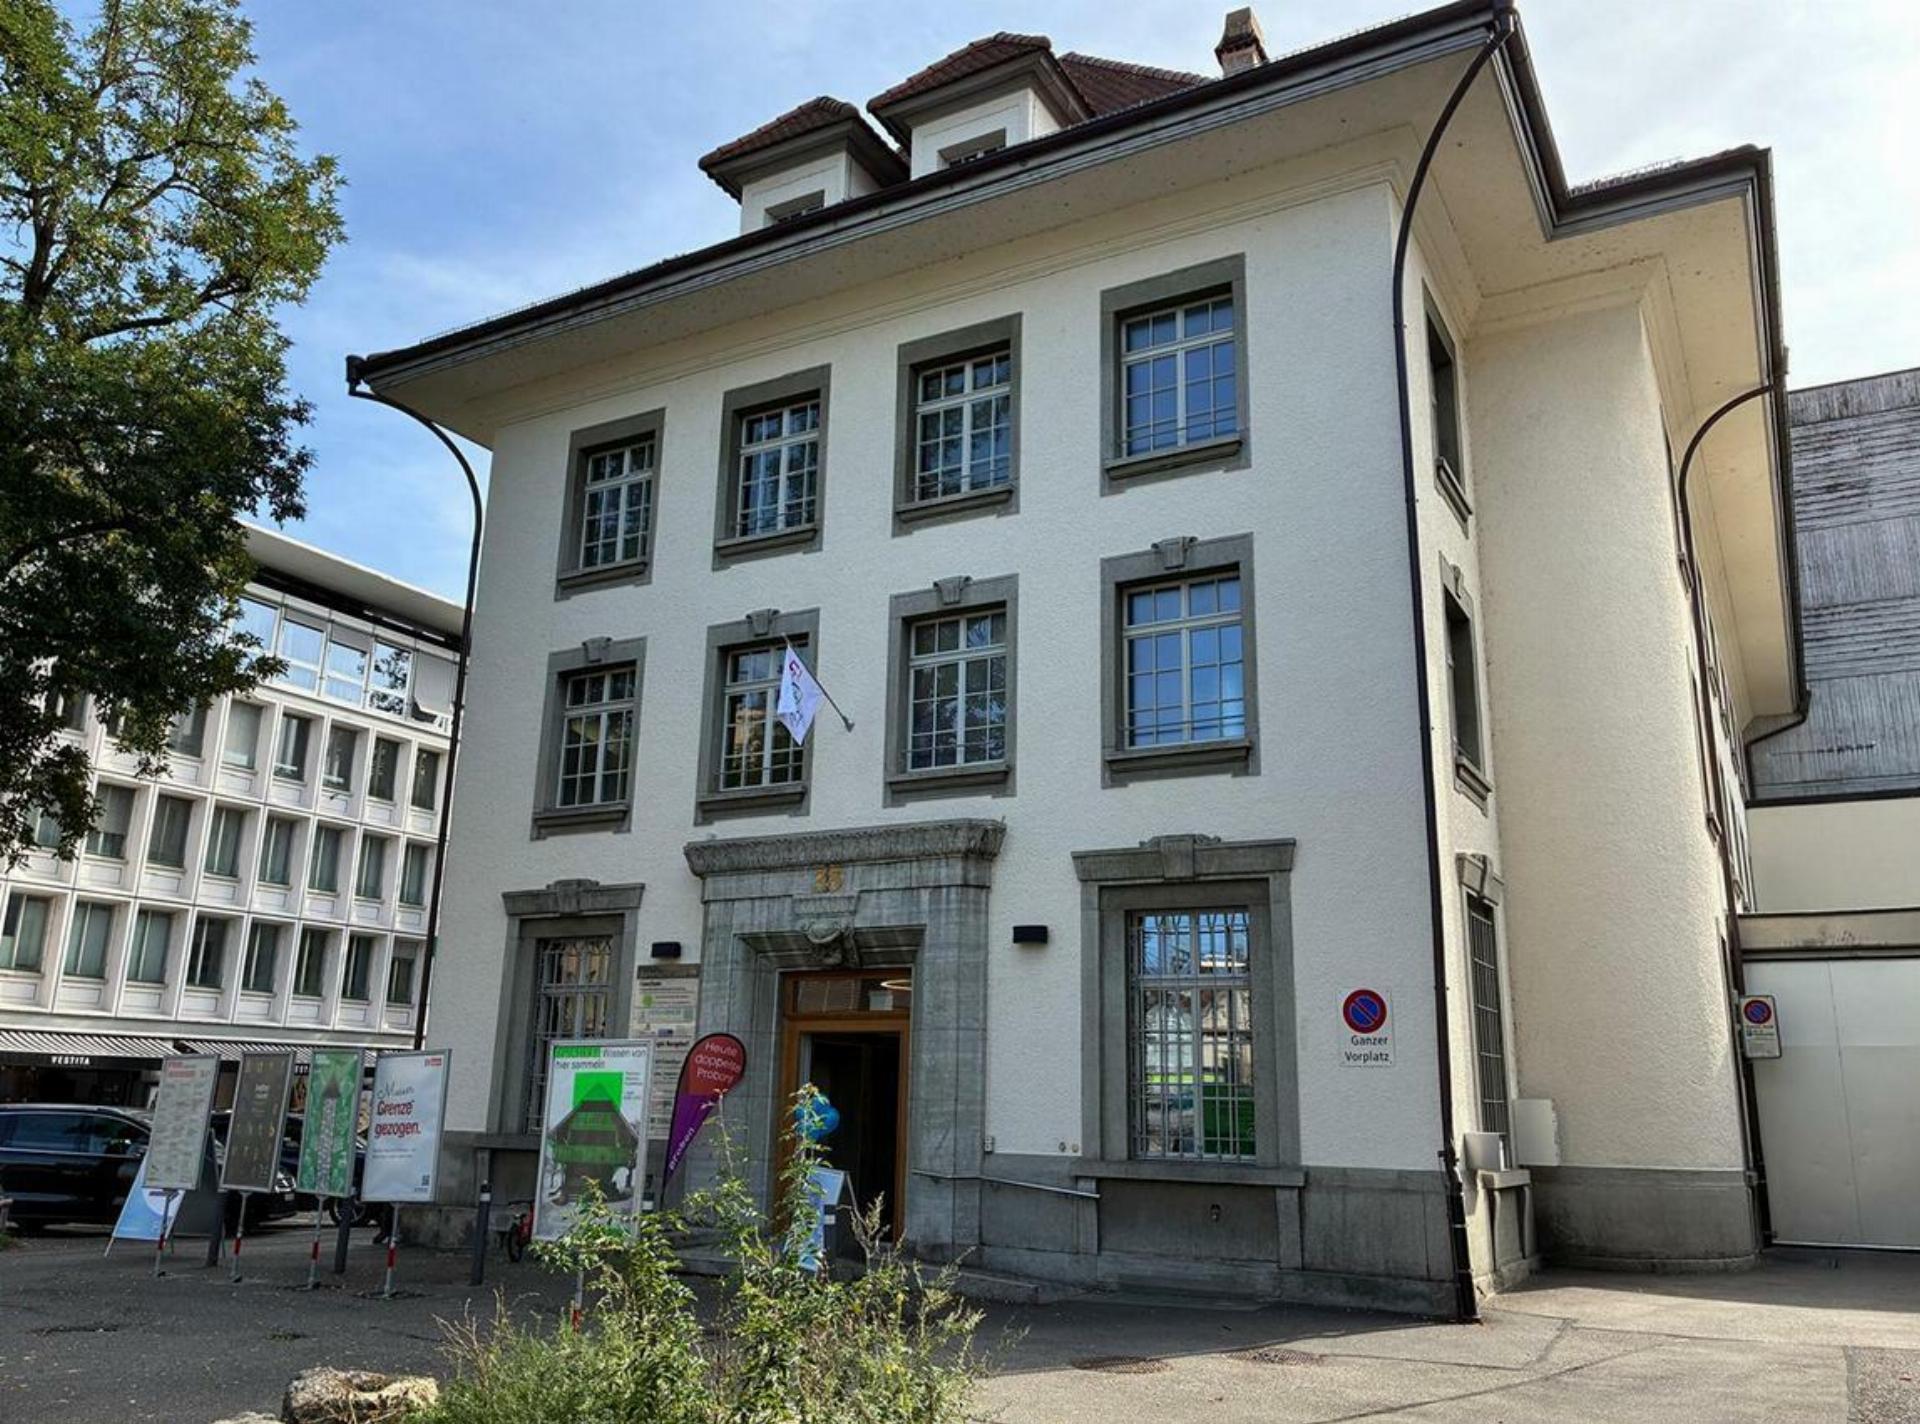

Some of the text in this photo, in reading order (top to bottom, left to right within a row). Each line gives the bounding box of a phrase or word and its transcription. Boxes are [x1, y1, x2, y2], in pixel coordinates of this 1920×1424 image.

[1351, 1034, 1388, 1047] Ganzer
[631, 1048, 647, 1058] von
[704, 1041, 738, 1057] Heute
[51, 1055, 90, 1065] VESTITA
[1344, 1050, 1389, 1064] Vorplatz
